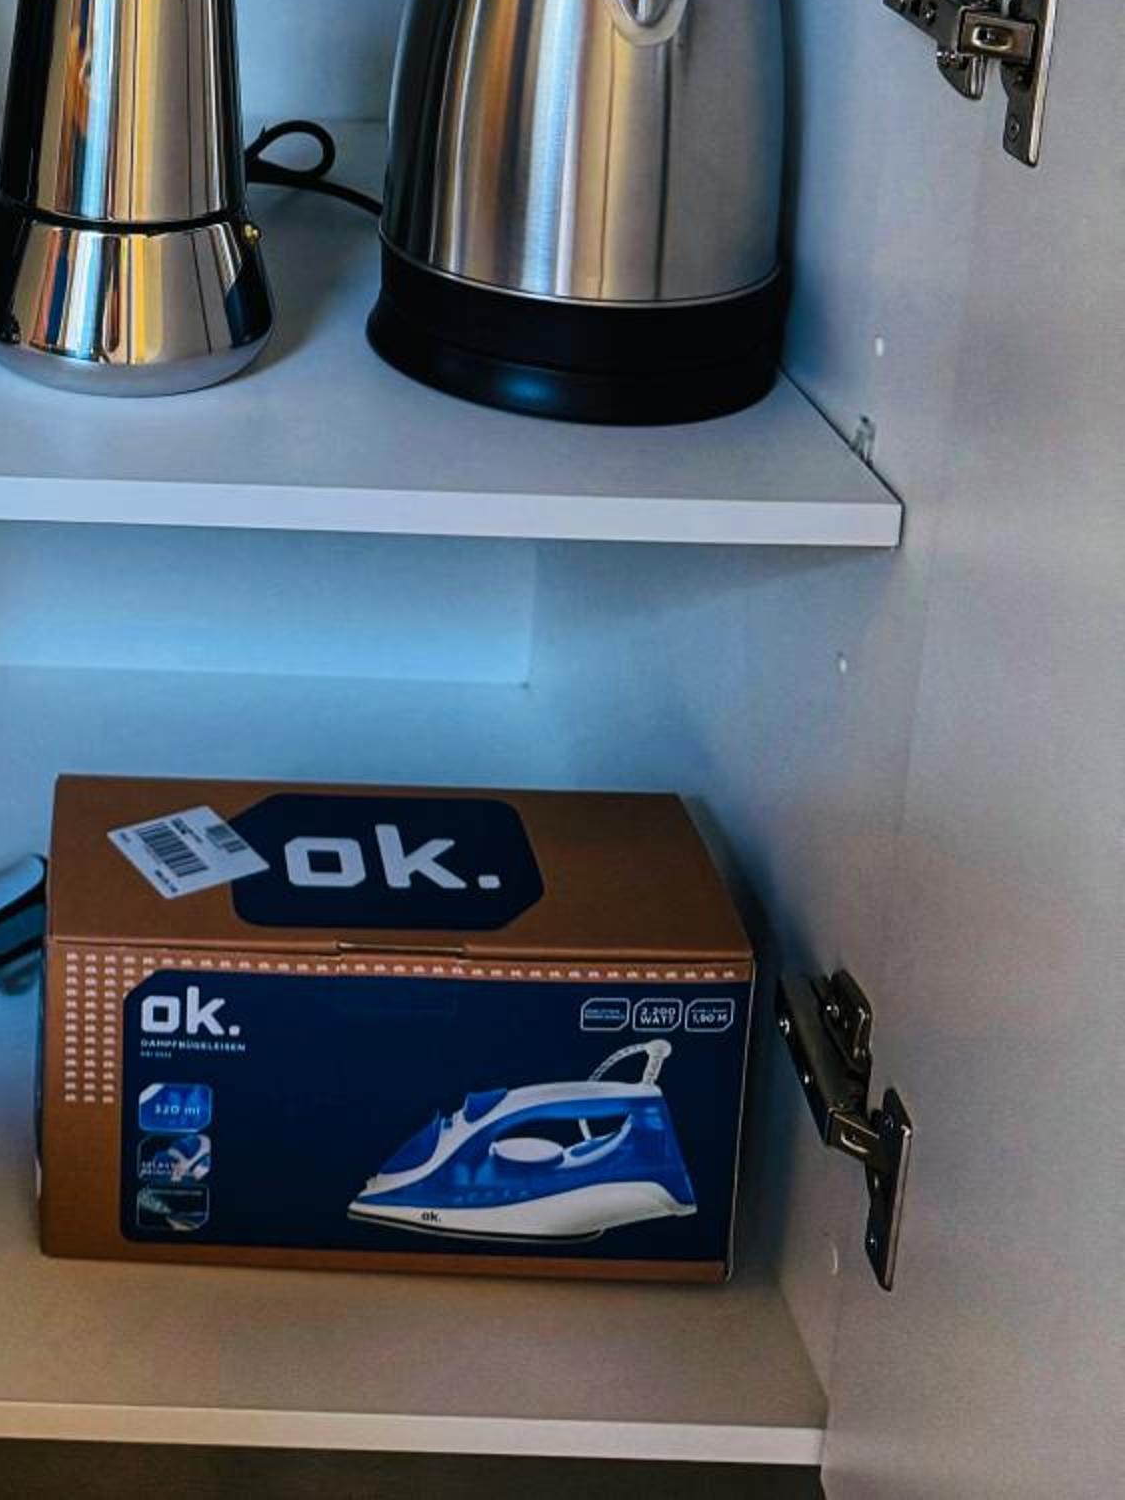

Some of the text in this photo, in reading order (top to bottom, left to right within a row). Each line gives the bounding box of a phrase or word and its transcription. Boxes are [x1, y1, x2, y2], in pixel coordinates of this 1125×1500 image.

[284, 823, 501, 889] ok.
[141, 985, 241, 1036] ok.
[640, 1015, 675, 1025] WATT
